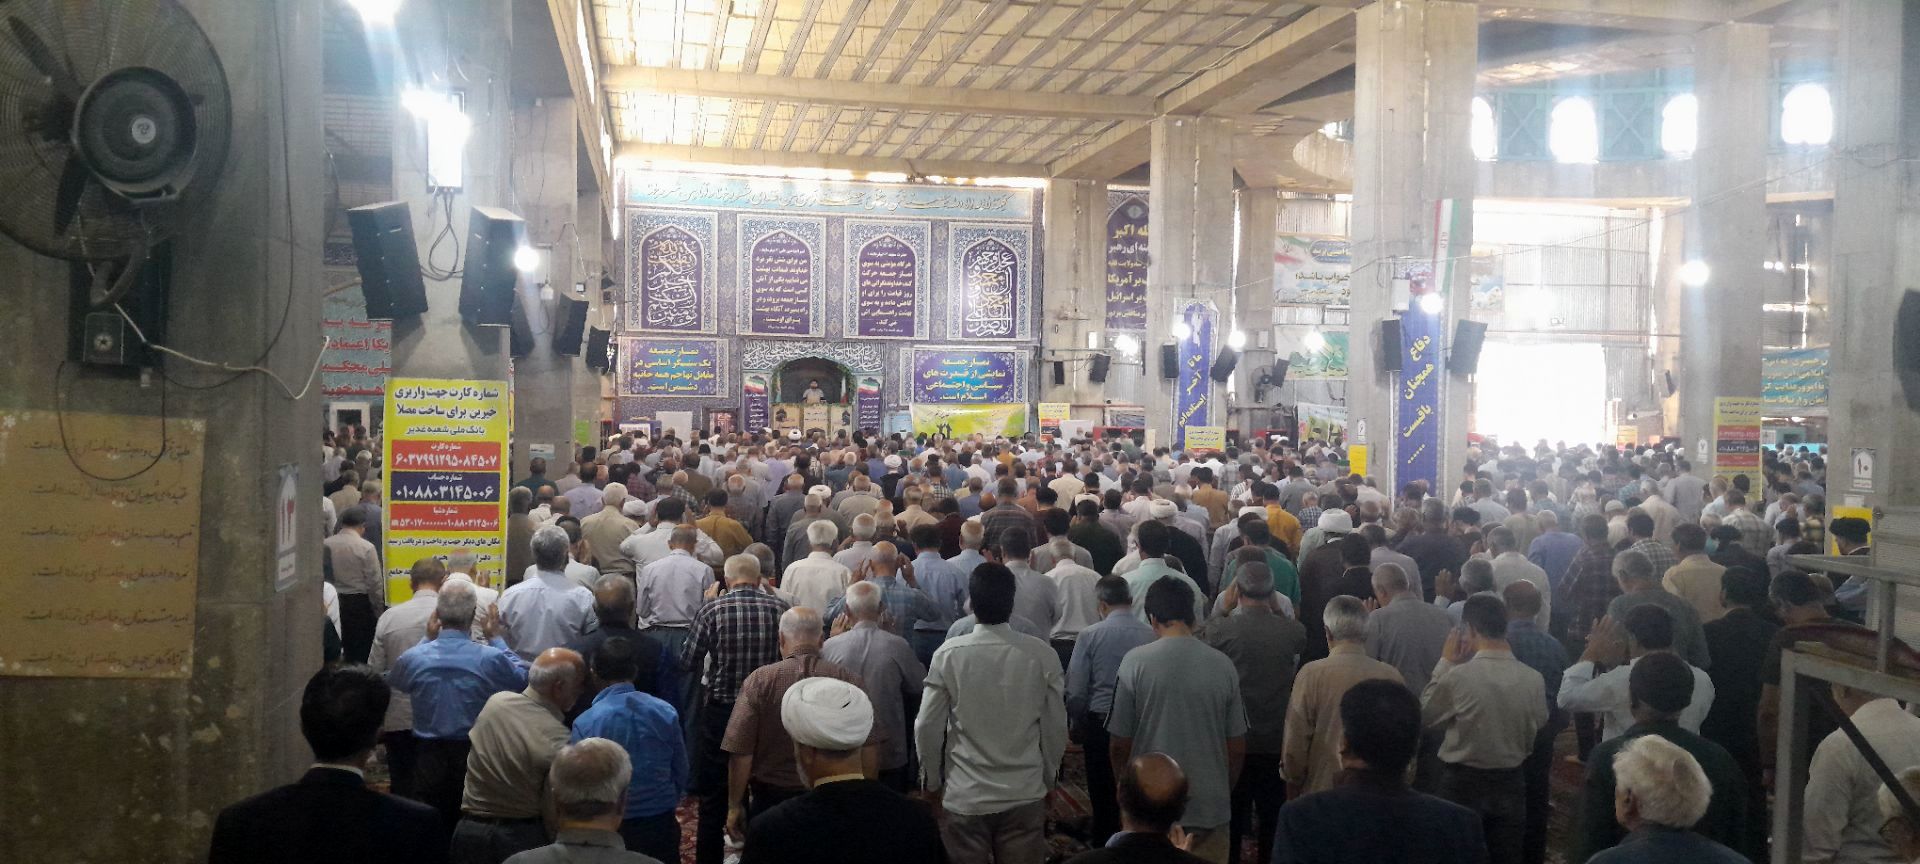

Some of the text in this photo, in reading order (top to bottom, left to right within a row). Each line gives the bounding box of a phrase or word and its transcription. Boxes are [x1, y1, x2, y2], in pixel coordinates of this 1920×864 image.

[1112, 224, 1134, 238] اکبر
[862, 269, 878, 278] حرکت
[898, 270, 912, 278] نماز
[1107, 271, 1133, 287] آمریکا
[868, 289, 880, 298] برای
[903, 290, 912, 298] روز
[648, 346, 699, 358] نماز جمعه
[1410, 335, 1432, 362] دفاع
[634, 358, 644, 368] در
[644, 358, 671, 368] اساسی
[672, 358, 698, 369] سنگر
[942, 357, 990, 368] نماز جمعه
[632, 369, 715, 380] مقابل تهاجم همه جانبه
[922, 368, 1006, 379] نمایشی از قدرت های
[668, 382, 699, 392] دشمن
[925, 380, 966, 390] اجتماعی
[970, 381, 1004, 391] سیاسی
[1186, 369, 1202, 396] آخر
[1404, 363, 1434, 400] همچنان
[394, 386, 425, 399] واریزی
[426, 387, 448, 399] جهت
[449, 386, 472, 400] کارت
[473, 388, 498, 400] شماره
[960, 392, 988, 402] اسلام
[396, 403, 497, 419] خیرین برای ساخت مصلا
[1403, 404, 1434, 438] باقیست
[406, 425, 485, 436] بانک ملی شعبه غدیر
[431, 442, 462, 452] شماره کارت
[1857, 457, 1870, 475] ۱۰
[428, 472, 462, 482] شماره حساب
[396, 484, 494, 500] ۰۱۰۸۸۰۳۱۴۵۰۰۶
